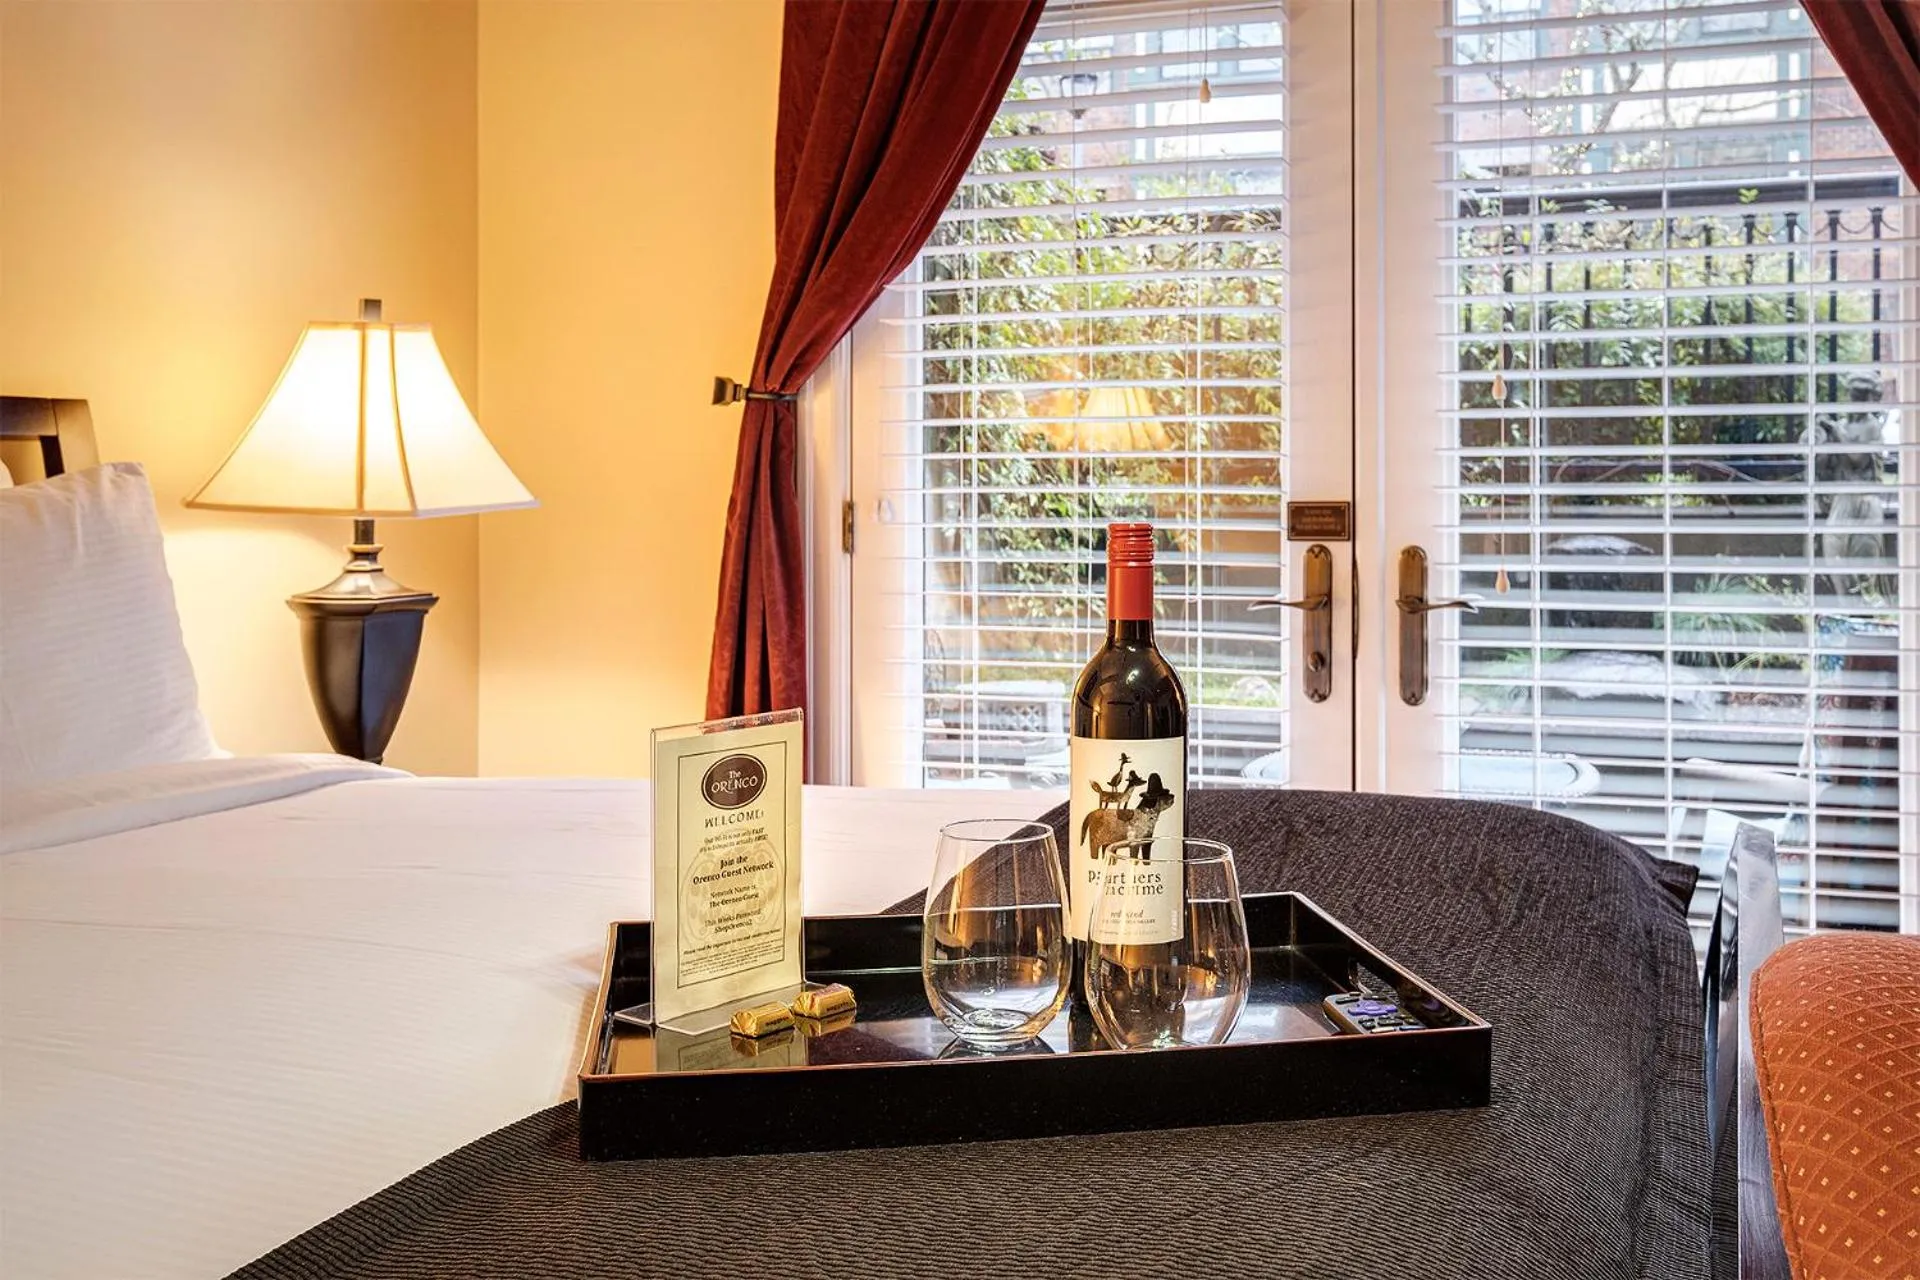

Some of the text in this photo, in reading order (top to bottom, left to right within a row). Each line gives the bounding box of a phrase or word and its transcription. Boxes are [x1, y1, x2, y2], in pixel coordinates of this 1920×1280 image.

[711, 775, 758, 794] ORENCO
[720, 855, 748, 870] Join the
[693, 861, 774, 885] Orenco Guest Network
